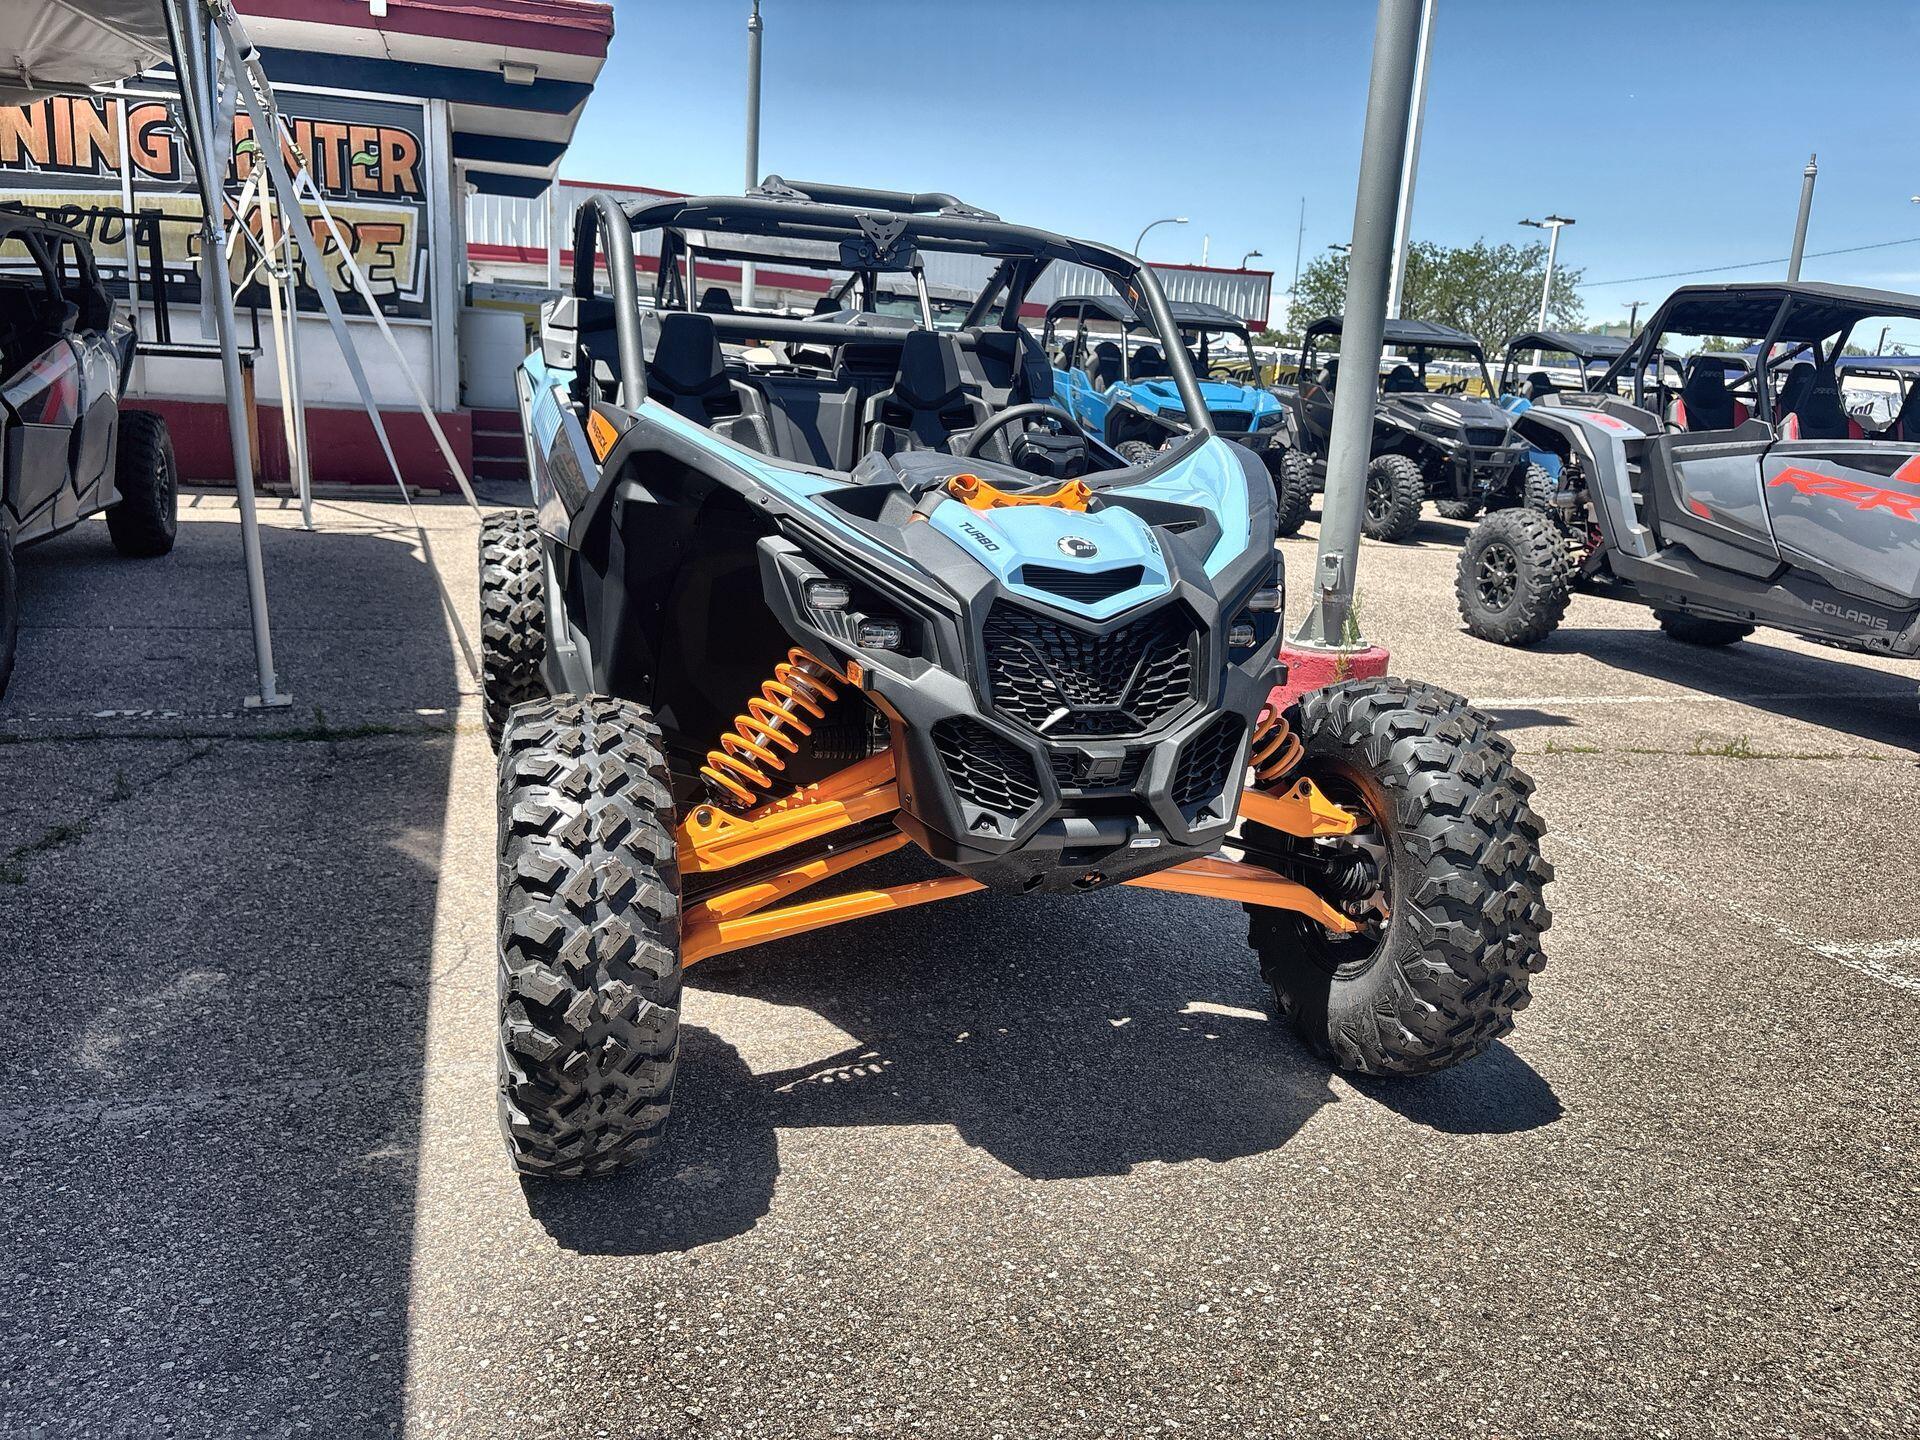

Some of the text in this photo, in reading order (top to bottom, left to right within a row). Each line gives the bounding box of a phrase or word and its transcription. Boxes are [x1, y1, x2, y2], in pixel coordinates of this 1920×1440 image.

[225, 112, 420, 195] ENTER
[1766, 466, 1920, 522] RZR
[959, 522, 1000, 551] TURBO
[1811, 599, 1888, 630] POLARIS
